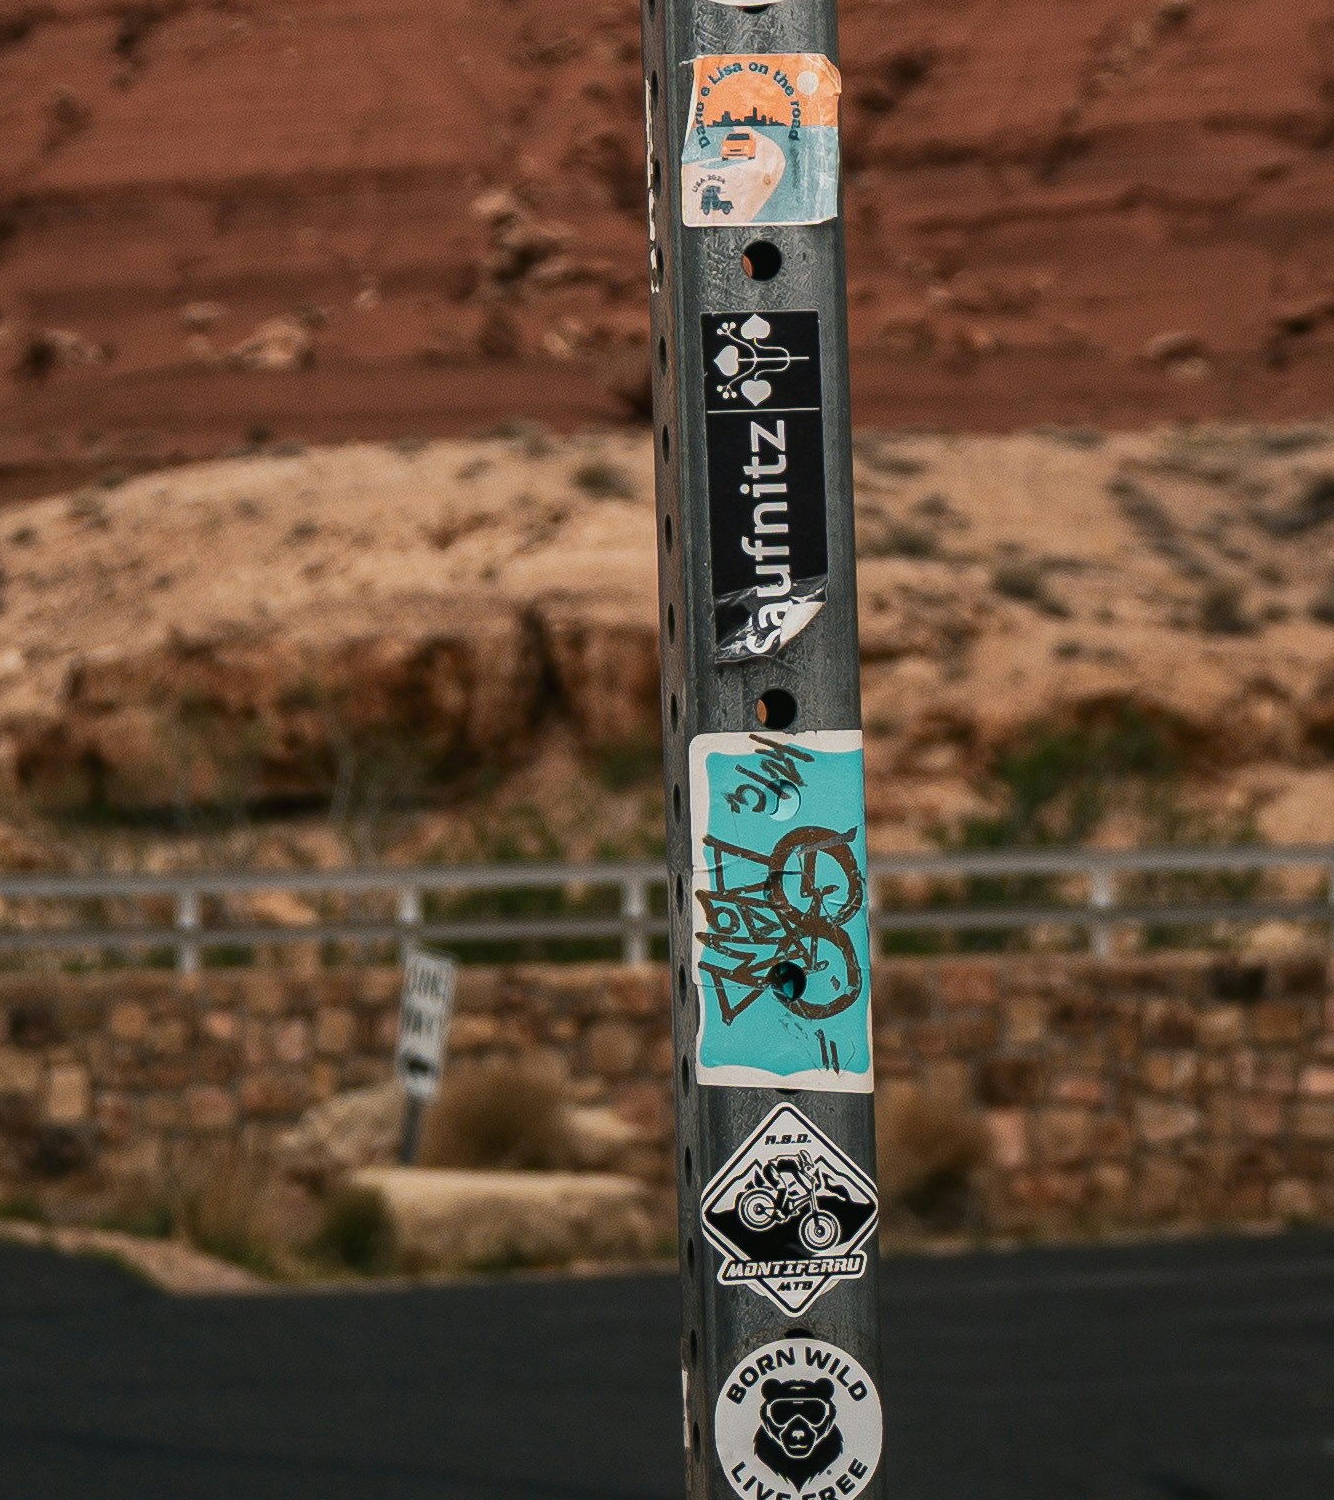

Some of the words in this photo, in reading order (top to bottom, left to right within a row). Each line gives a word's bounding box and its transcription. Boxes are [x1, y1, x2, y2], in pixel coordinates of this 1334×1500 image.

[708, 62, 744, 85] Lisa
[749, 62, 769, 75] on
[773, 69, 794, 96] the
[788, 100, 801, 140] road
[726, 1257, 861, 1278] MONTIFERRU
[777, 1280, 814, 1291] MTB
[726, 1346, 796, 1405] BORN
[805, 1346, 868, 1401] WILD
